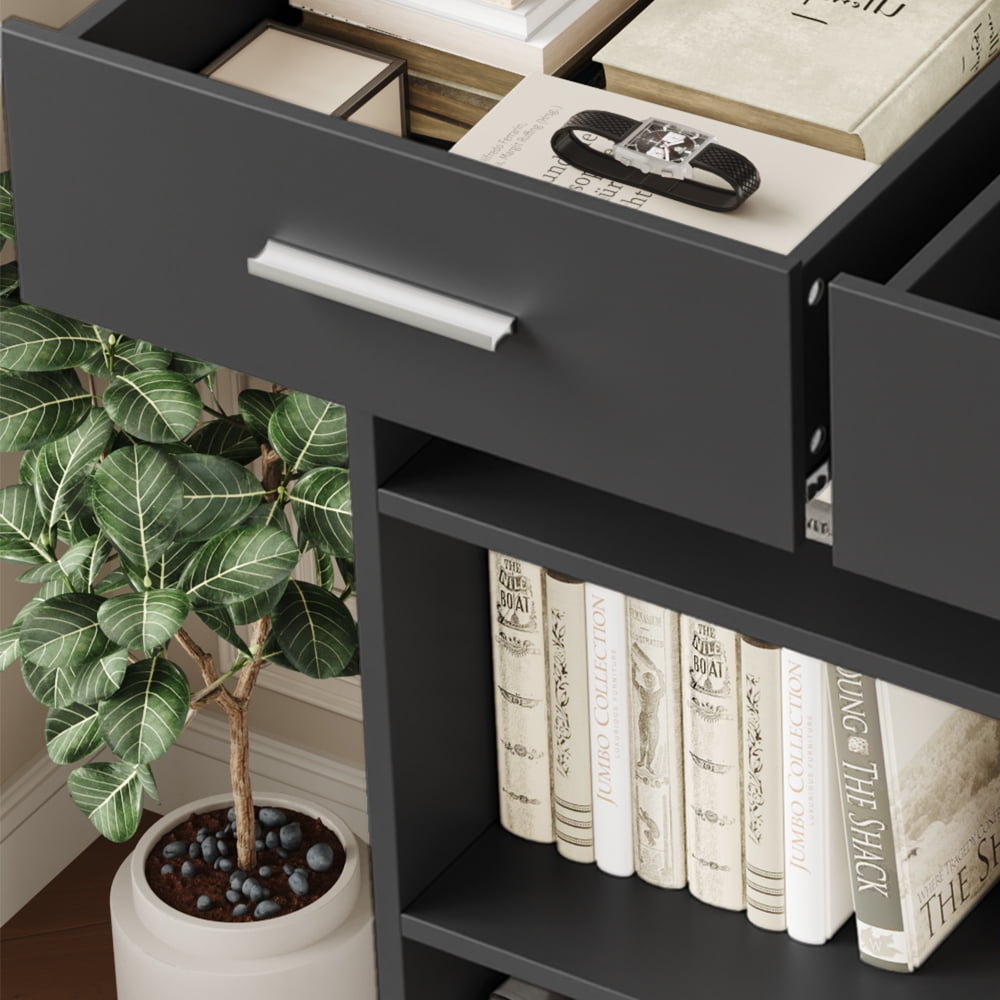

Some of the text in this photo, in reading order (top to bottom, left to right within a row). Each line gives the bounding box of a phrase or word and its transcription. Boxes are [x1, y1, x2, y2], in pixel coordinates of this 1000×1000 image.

[503, 558, 522, 574] THE
[498, 570, 529, 591] NILE
[500, 589, 530, 613] BOAT
[697, 623, 716, 639] THE
[692, 634, 721, 656] NILE
[693, 655, 723, 678] BOAT
[591, 593, 617, 807] JUMBO COLLECTION
[786, 660, 812, 875] JUMBO COLLECTION
[842, 760, 878, 811] THE
[848, 812, 889, 898] SHACK
[920, 865, 972, 939] THE
